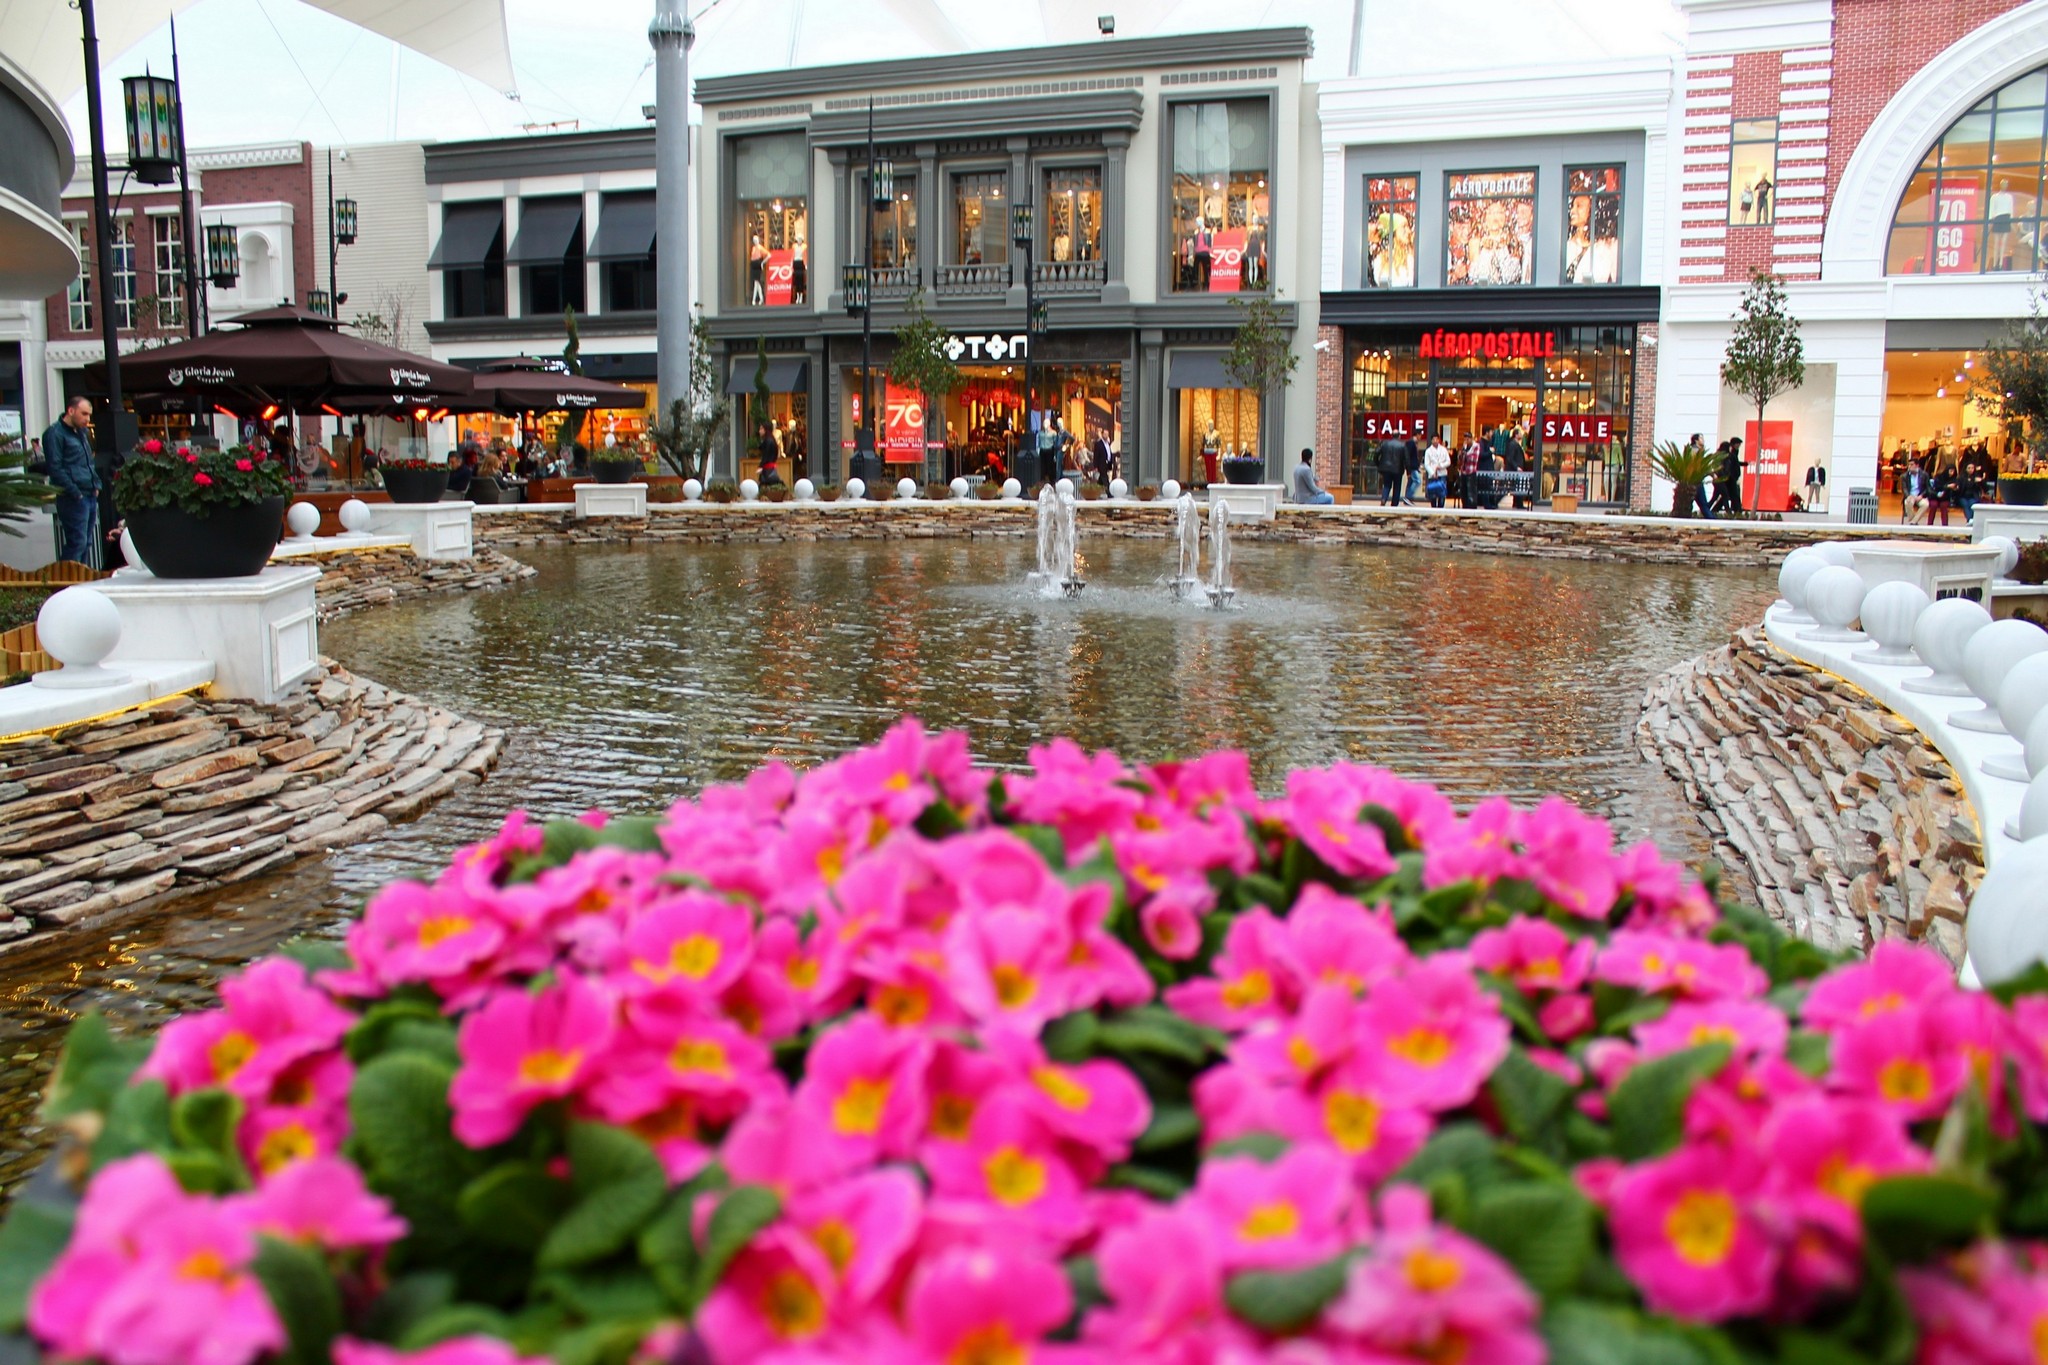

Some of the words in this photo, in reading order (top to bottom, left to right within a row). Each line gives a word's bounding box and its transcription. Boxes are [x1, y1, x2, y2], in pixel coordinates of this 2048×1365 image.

[1455, 176, 1529, 195] AÉROPOSTALE
[1939, 199, 1966, 222] 70
[1937, 227, 1963, 249] 60
[1213, 248, 1241, 265] 70
[1938, 250, 1960, 268] 50
[769, 265, 793, 281] 70
[1419, 328, 1556, 359] AÉROPOSTALE
[185, 366, 211, 377] Gloria
[887, 403, 924, 428] 70
[1366, 419, 1424, 435] SALE
[1545, 421, 1608, 438] SALE
